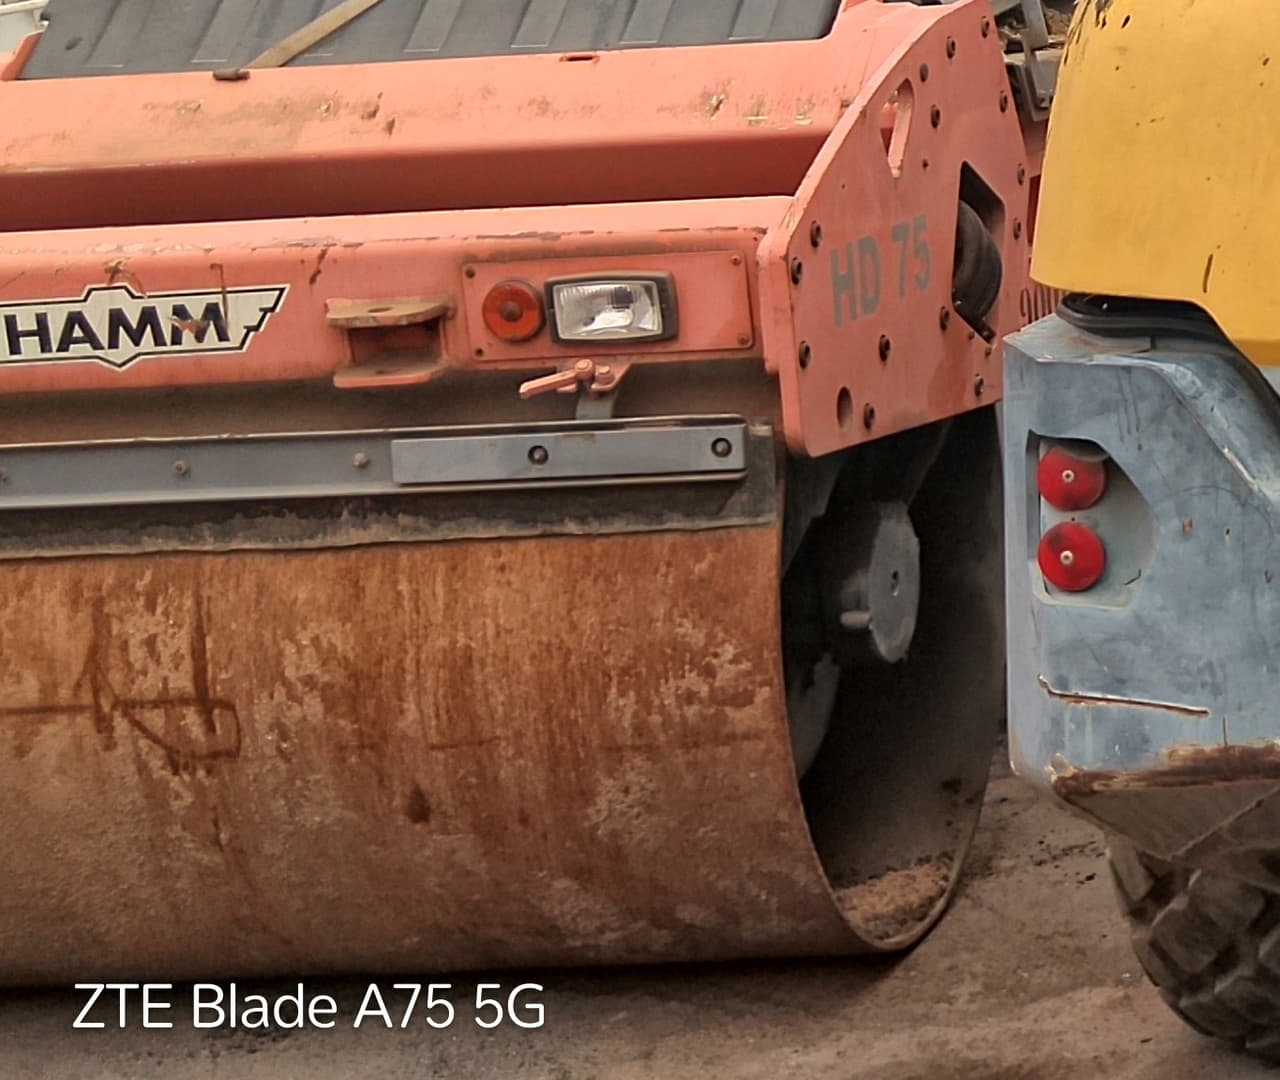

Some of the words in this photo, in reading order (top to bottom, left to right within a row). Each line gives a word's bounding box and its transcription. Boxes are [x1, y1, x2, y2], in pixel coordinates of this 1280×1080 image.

[831, 235, 881, 329] HD
[891, 214, 932, 302] 75
[3, 301, 231, 356] HAMM
